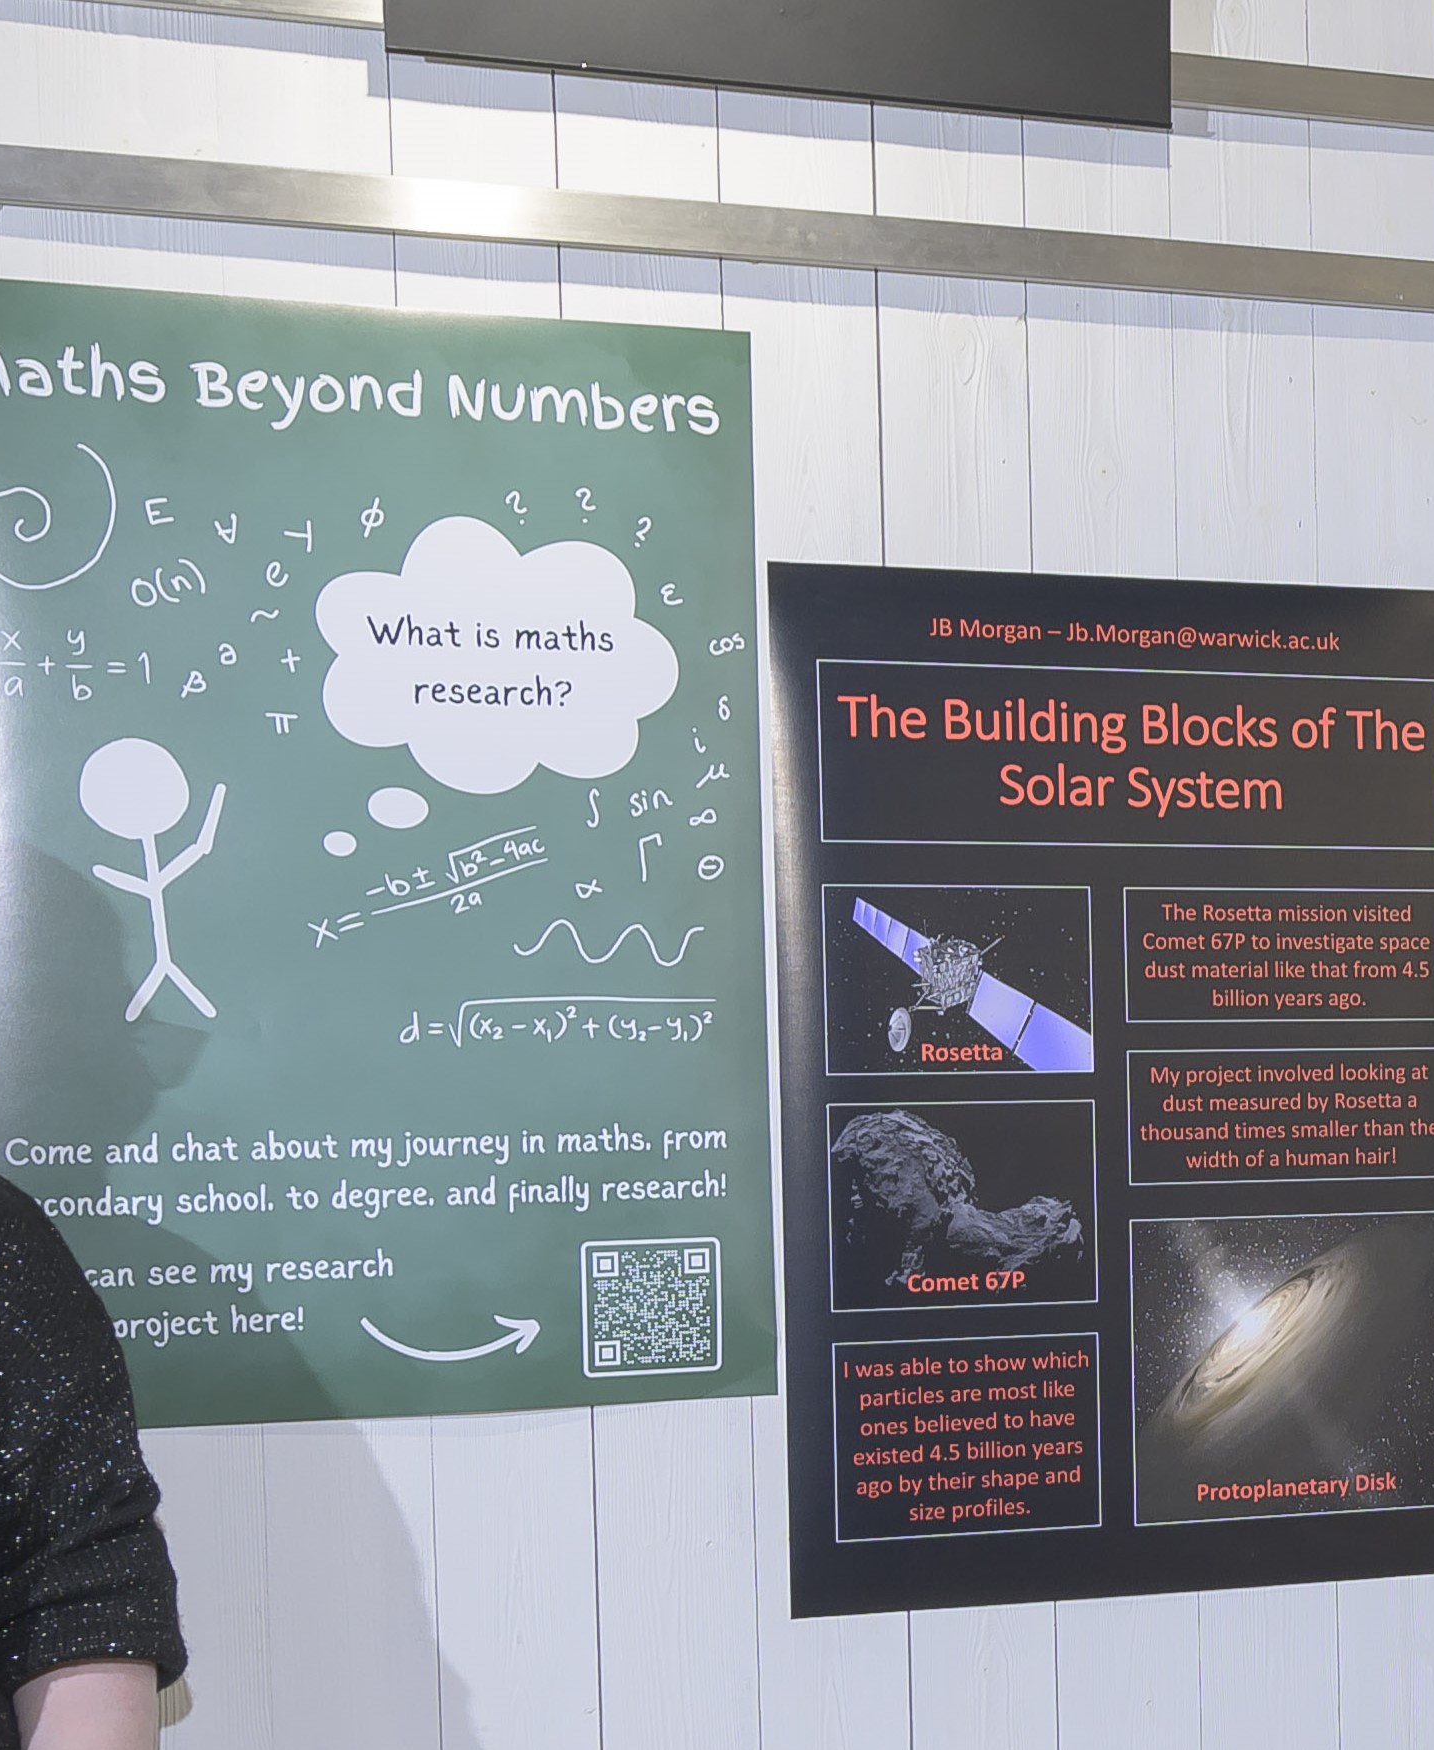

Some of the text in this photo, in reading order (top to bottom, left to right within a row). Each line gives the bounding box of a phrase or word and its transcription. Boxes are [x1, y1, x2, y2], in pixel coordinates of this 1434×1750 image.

[191, 362, 422, 430] Beyond
[449, 375, 719, 435] Numbers
[367, 614, 613, 652] What is maths
[930, 618, 953, 637] JB
[960, 619, 1041, 644] Morgan
[1067, 623, 1340, 651] Jb.Morgan@warwick.ac.uk
[415, 675, 571, 706] research?
[837, 694, 1425, 754] The Building Blocks of The
[1000, 763, 1282, 817] Solar System
[1163, 904, 1411, 922] The Rosetta mission visited
[1143, 932, 1429, 954] Comet 67P to investigate space
[1145, 960, 1429, 979] dust material like that from 4.5
[1212, 990, 1366, 1011] billion years ago.
[922, 1044, 1002, 1061] Rosetta
[1150, 1065, 1427, 1087] My project involved looking at
[1162, 1093, 1417, 1112] dust measured by Rosetta a
[1141, 1123, 1229, 1140] thousand
[1235, 1125, 1285, 1138] times
[1292, 1120, 1357, 1138] smaller
[1364, 1121, 1404, 1136] than
[5, 1138, 92, 1165] Come
[106, 1132, 158, 1163] and
[172, 1132, 239, 1161] chat
[251, 1130, 338, 1160] about
[352, 1138, 392, 1165] my
[397, 1132, 509, 1165] journey
[523, 1130, 545, 1153] in
[664, 1130, 727, 1159] from
[1186, 1148, 1395, 1168] width of a human hair!
[35, 1185, 162, 1224] condary
[286, 1186, 318, 1210] to
[447, 1175, 495, 1205] and
[509, 1175, 589, 1213] finally
[603, 1169, 726, 1201] research!
[148, 1265, 197, 1285] see
[211, 1263, 252, 1292] my
[267, 1248, 393, 1282] research
[908, 1272, 1024, 1292] Comet 67P
[231, 1304, 303, 1333] here!
[844, 1350, 1089, 1377] I was able to show which
[859, 1381, 1074, 1409] particles are most like
[1198, 1473, 1395, 1501] Protoplanetary Disk
